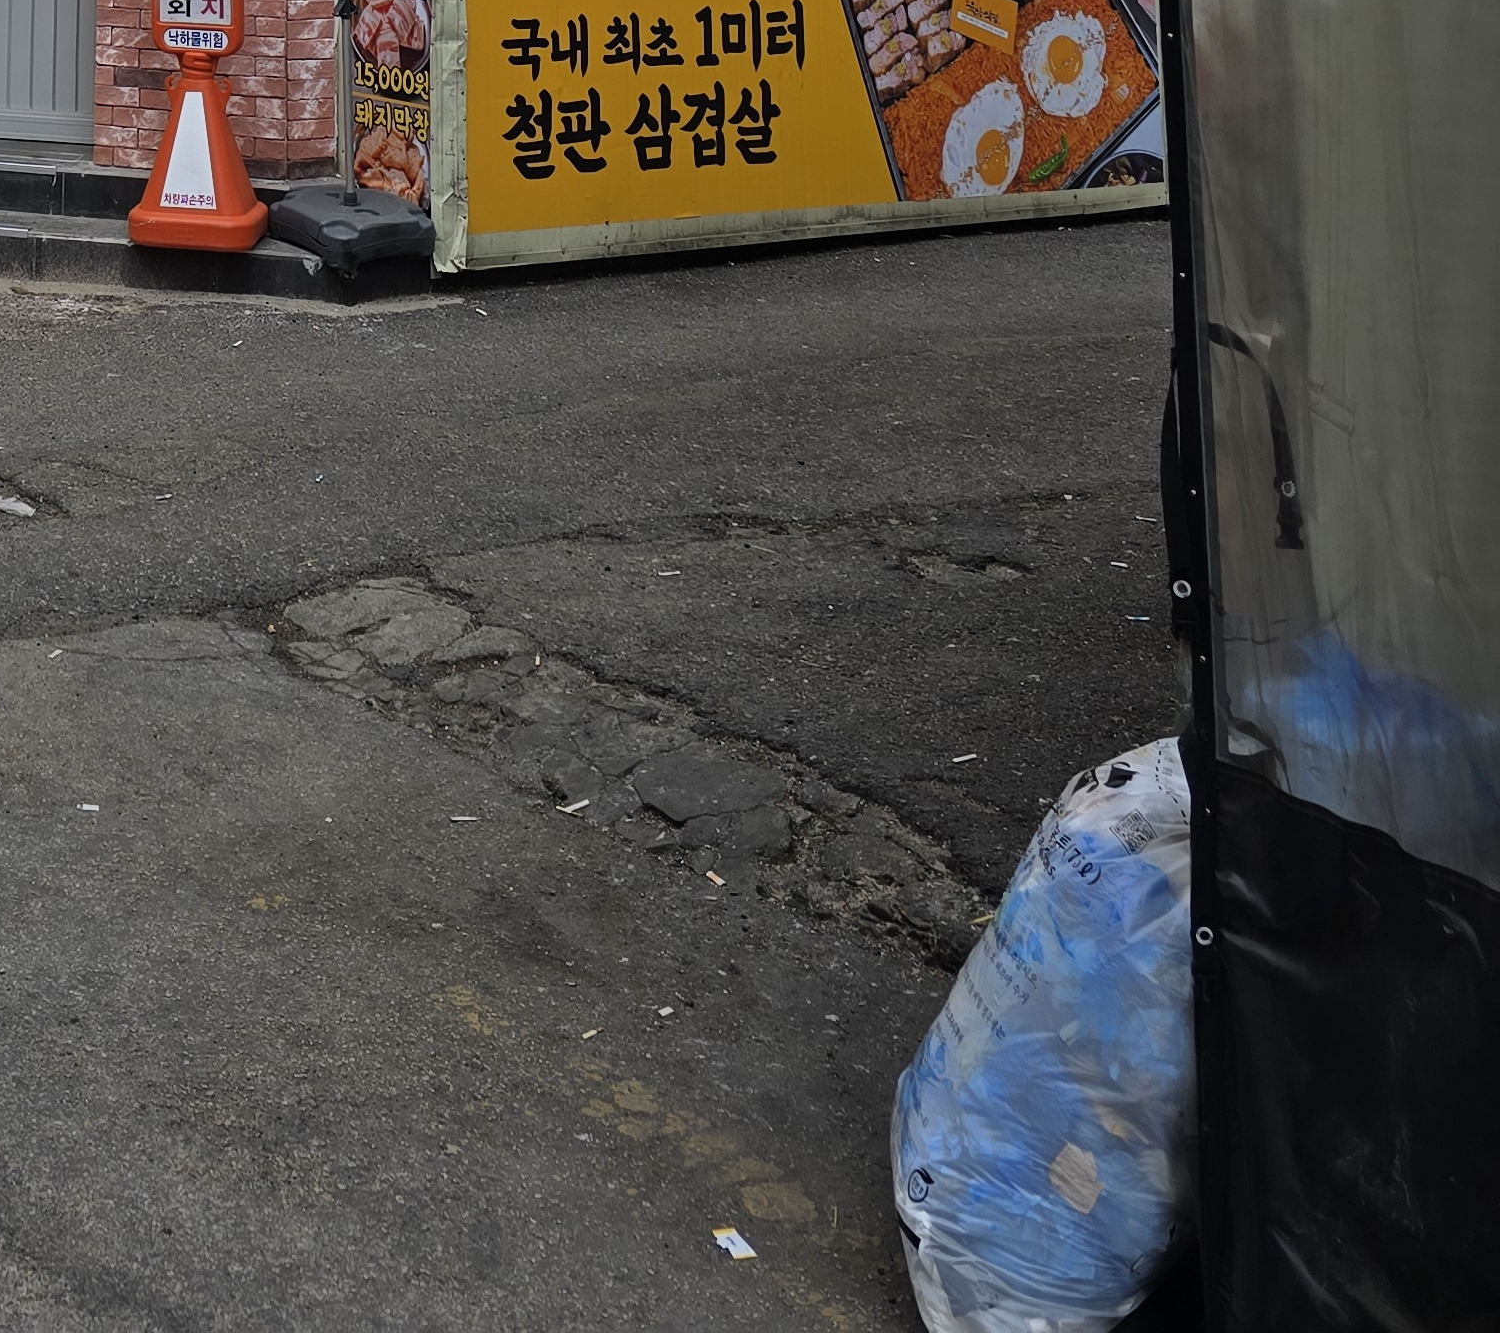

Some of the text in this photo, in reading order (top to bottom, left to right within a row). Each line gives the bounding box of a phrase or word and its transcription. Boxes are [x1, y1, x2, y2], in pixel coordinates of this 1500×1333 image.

[168, 29, 224, 49] 낙하물위험
[500, 13, 591, 82] 국내
[603, 12, 684, 75] 최초
[355, 61, 429, 101] 15,000원
[354, 99, 429, 143] 돼지막창
[501, 77, 782, 181] 철판 삼겹살
[163, 193, 215, 207] 차량파손주의
